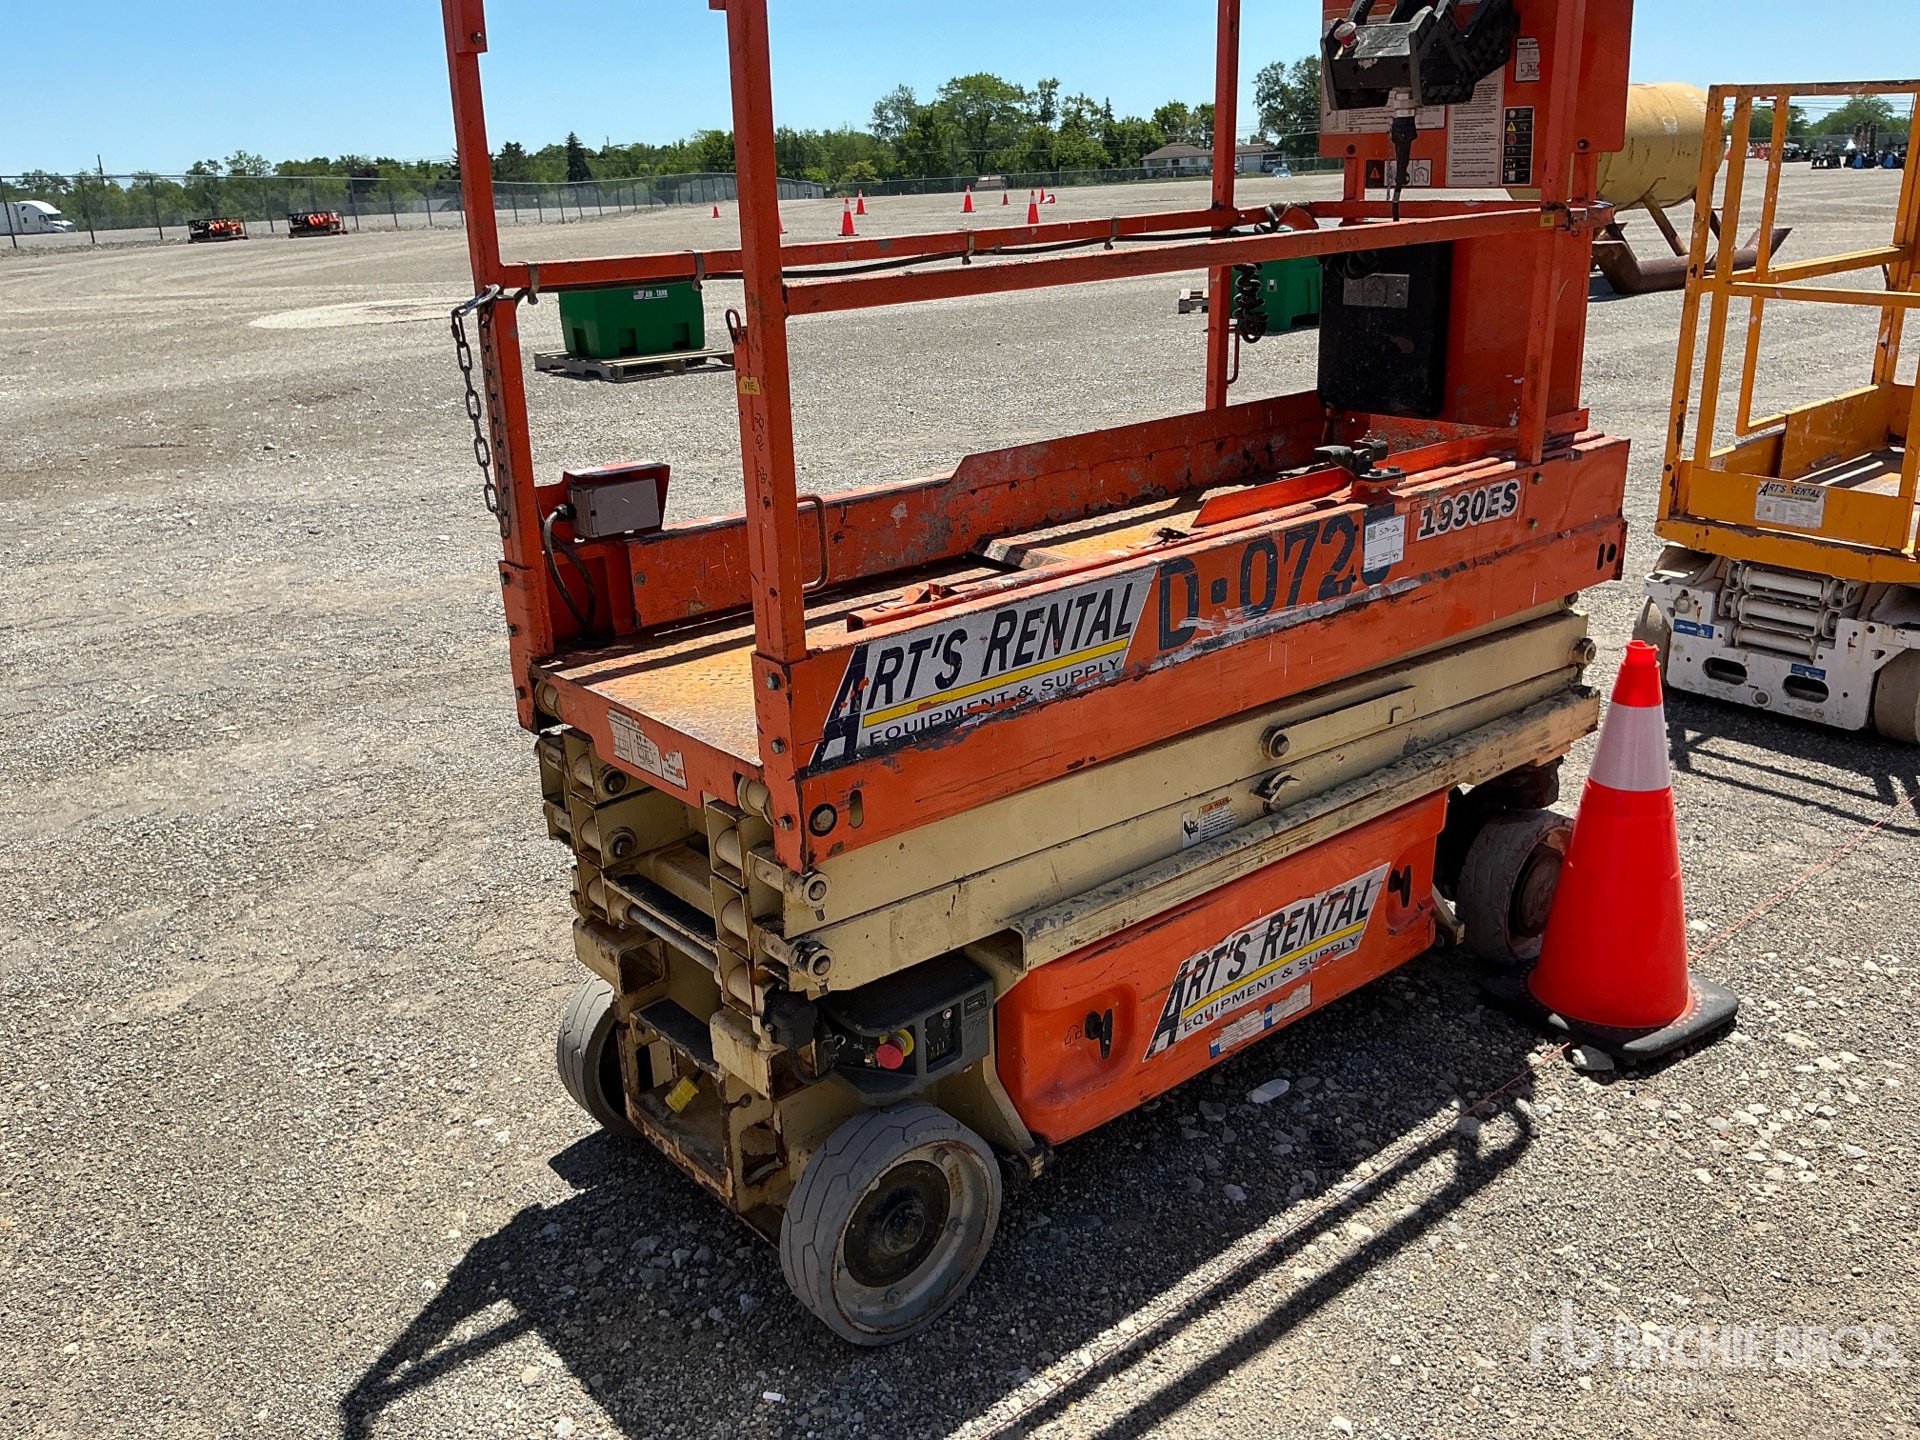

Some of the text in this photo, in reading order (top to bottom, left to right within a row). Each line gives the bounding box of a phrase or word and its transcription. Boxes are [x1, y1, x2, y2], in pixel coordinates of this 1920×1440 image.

[1418, 480, 1521, 538] 1930ES
[1758, 482, 1821, 498] ART'S RENTAL
[807, 583, 1133, 776] ART'S RENTAL
[868, 657, 1121, 746] EQUIPMENT & SUPPLY
[1145, 933, 1251, 1061] ART'S
[1258, 879, 1372, 966] RENTAL
[1183, 975, 1277, 1033] EQUIPMENT
[1281, 966, 1294, 979] &
[1298, 935, 1358, 971] SUPPLY
